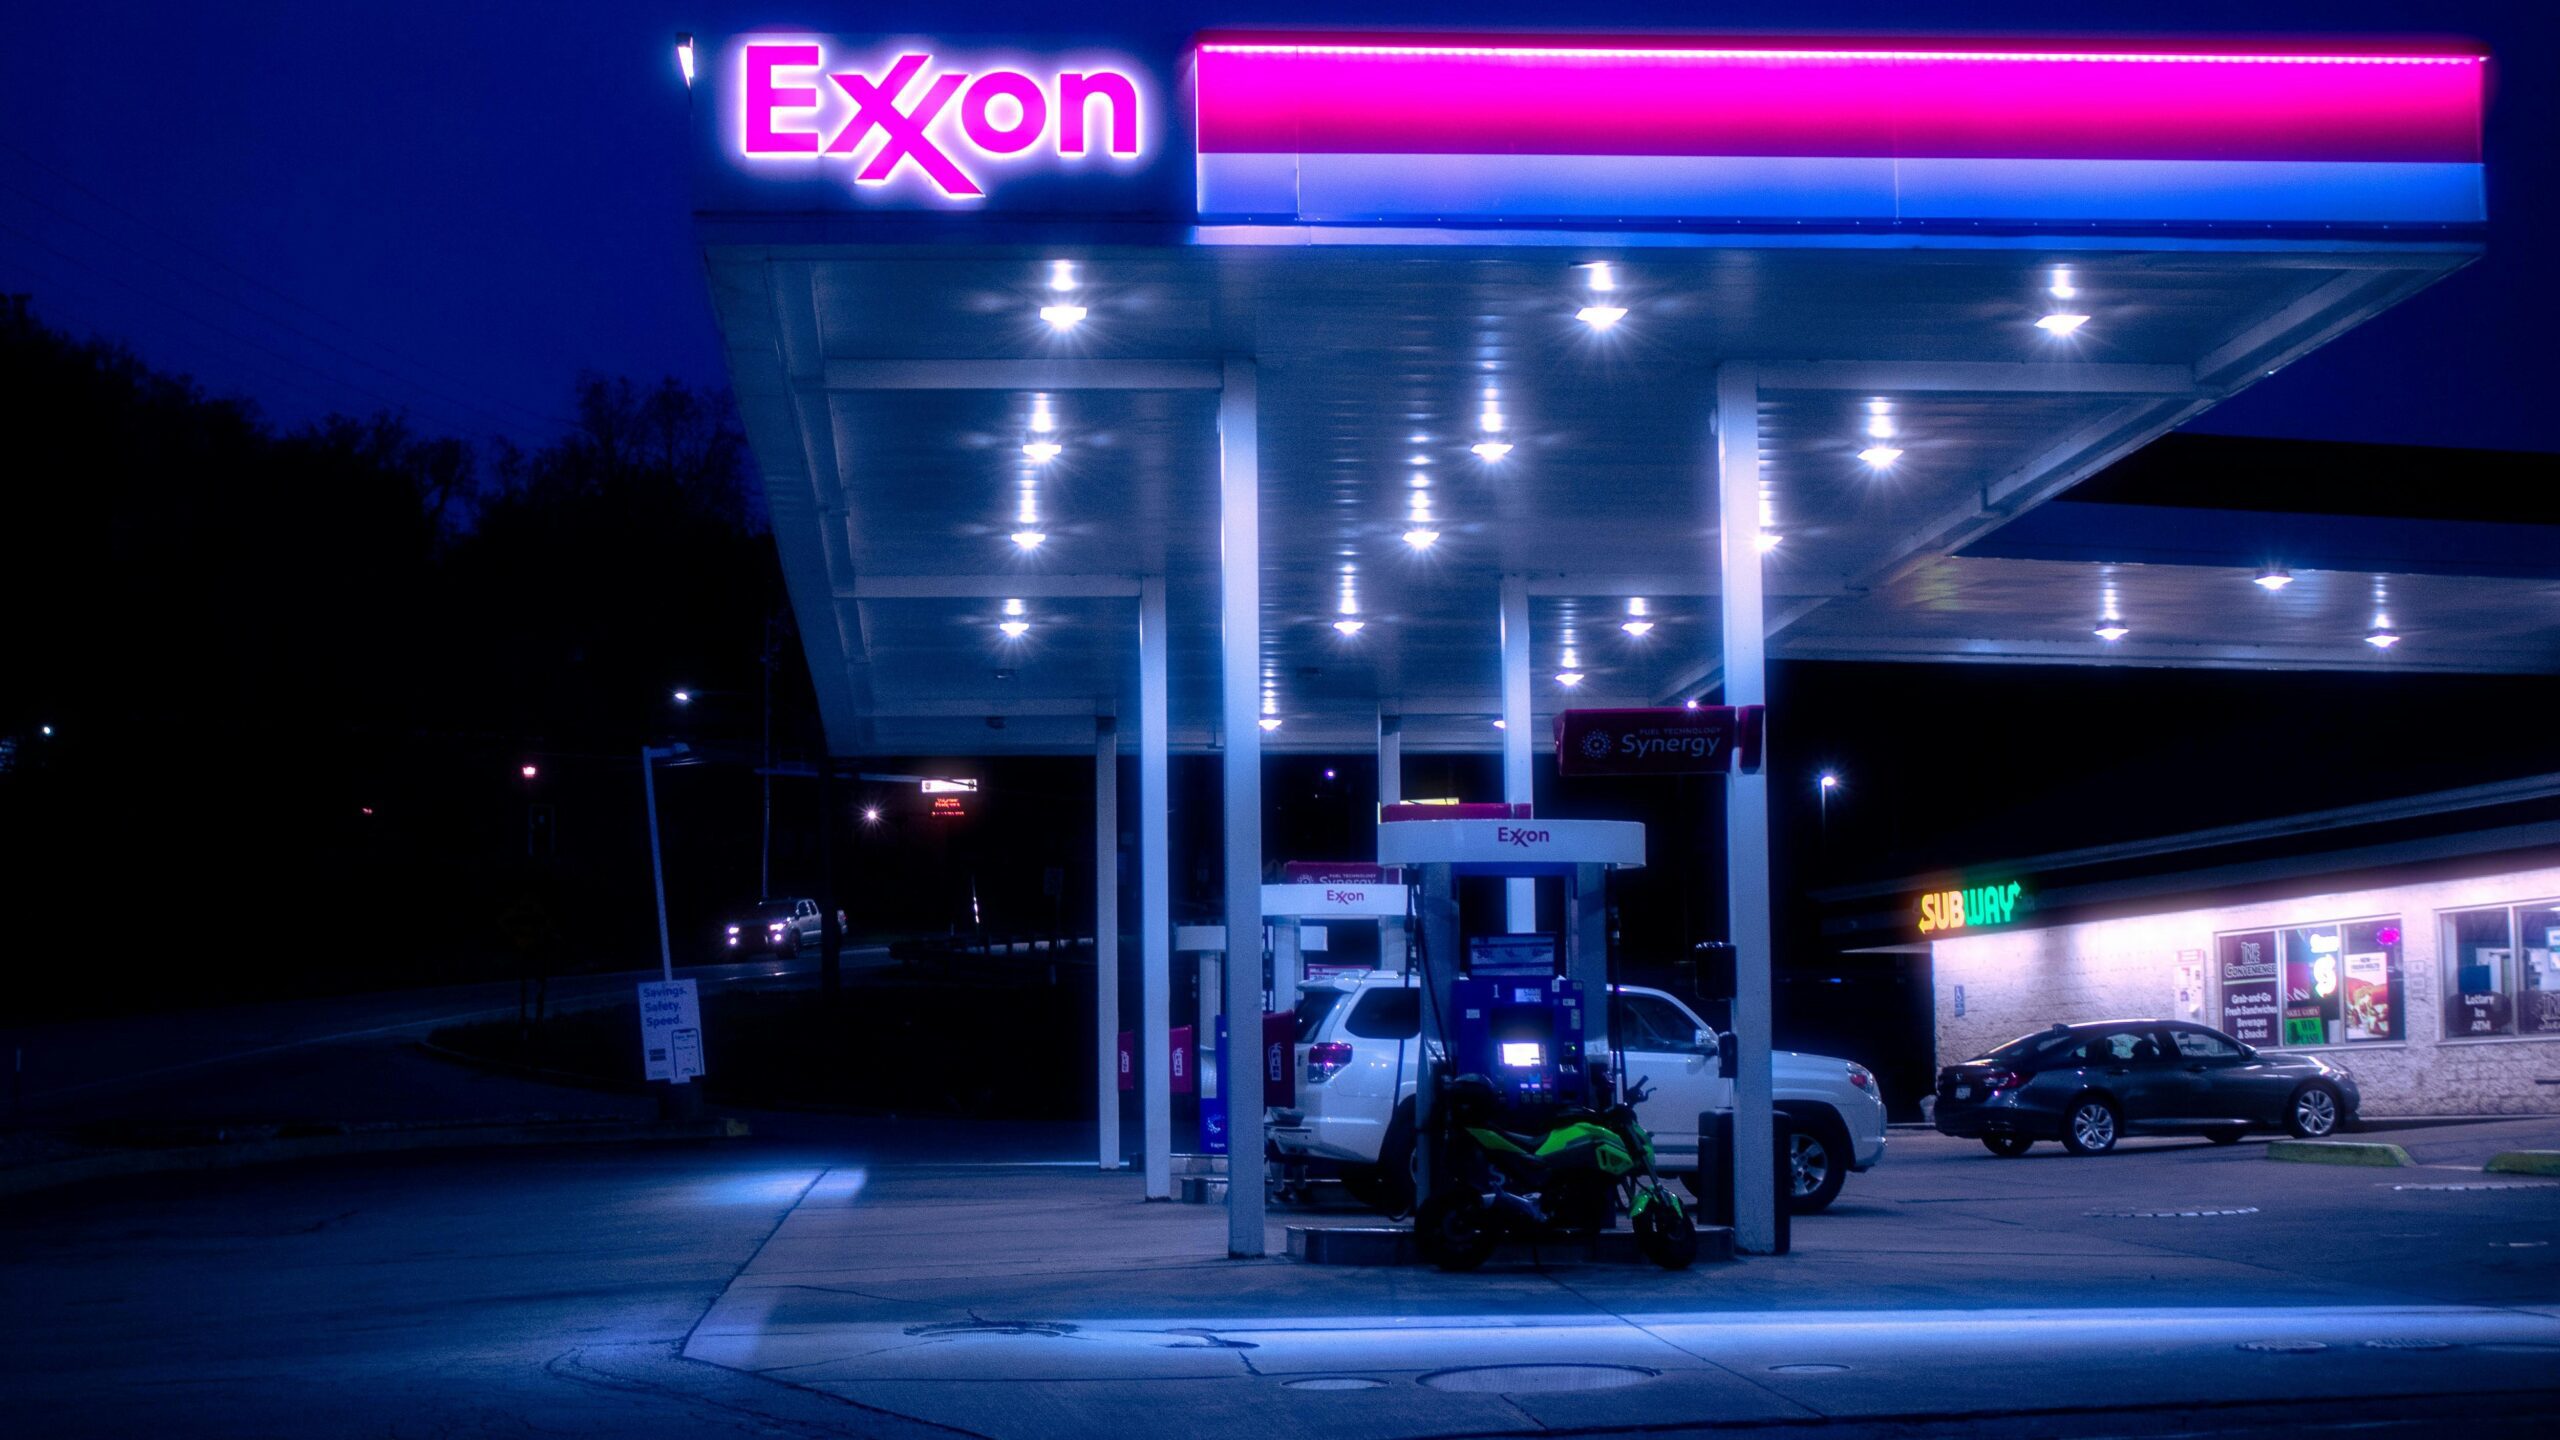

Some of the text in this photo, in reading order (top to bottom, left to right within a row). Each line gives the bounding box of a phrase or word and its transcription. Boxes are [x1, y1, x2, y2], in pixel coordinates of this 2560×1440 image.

[744, 45, 1139, 197] Exxon
[1639, 727, 1722, 736] FUEL TECHNOLOGY
[1621, 733, 1721, 758] Synergy
[1498, 827, 1549, 847] Exxon
[1326, 889, 1364, 905] Exxon
[1918, 880, 2021, 934] SUBWAY
[643, 986, 687, 998] Savings.
[1493, 984, 1500, 998] 1
[645, 1001, 682, 1012] Safety.
[2224, 1006, 2242, 1017] Fresh
[2470, 1020, 2492, 1031] ATM
